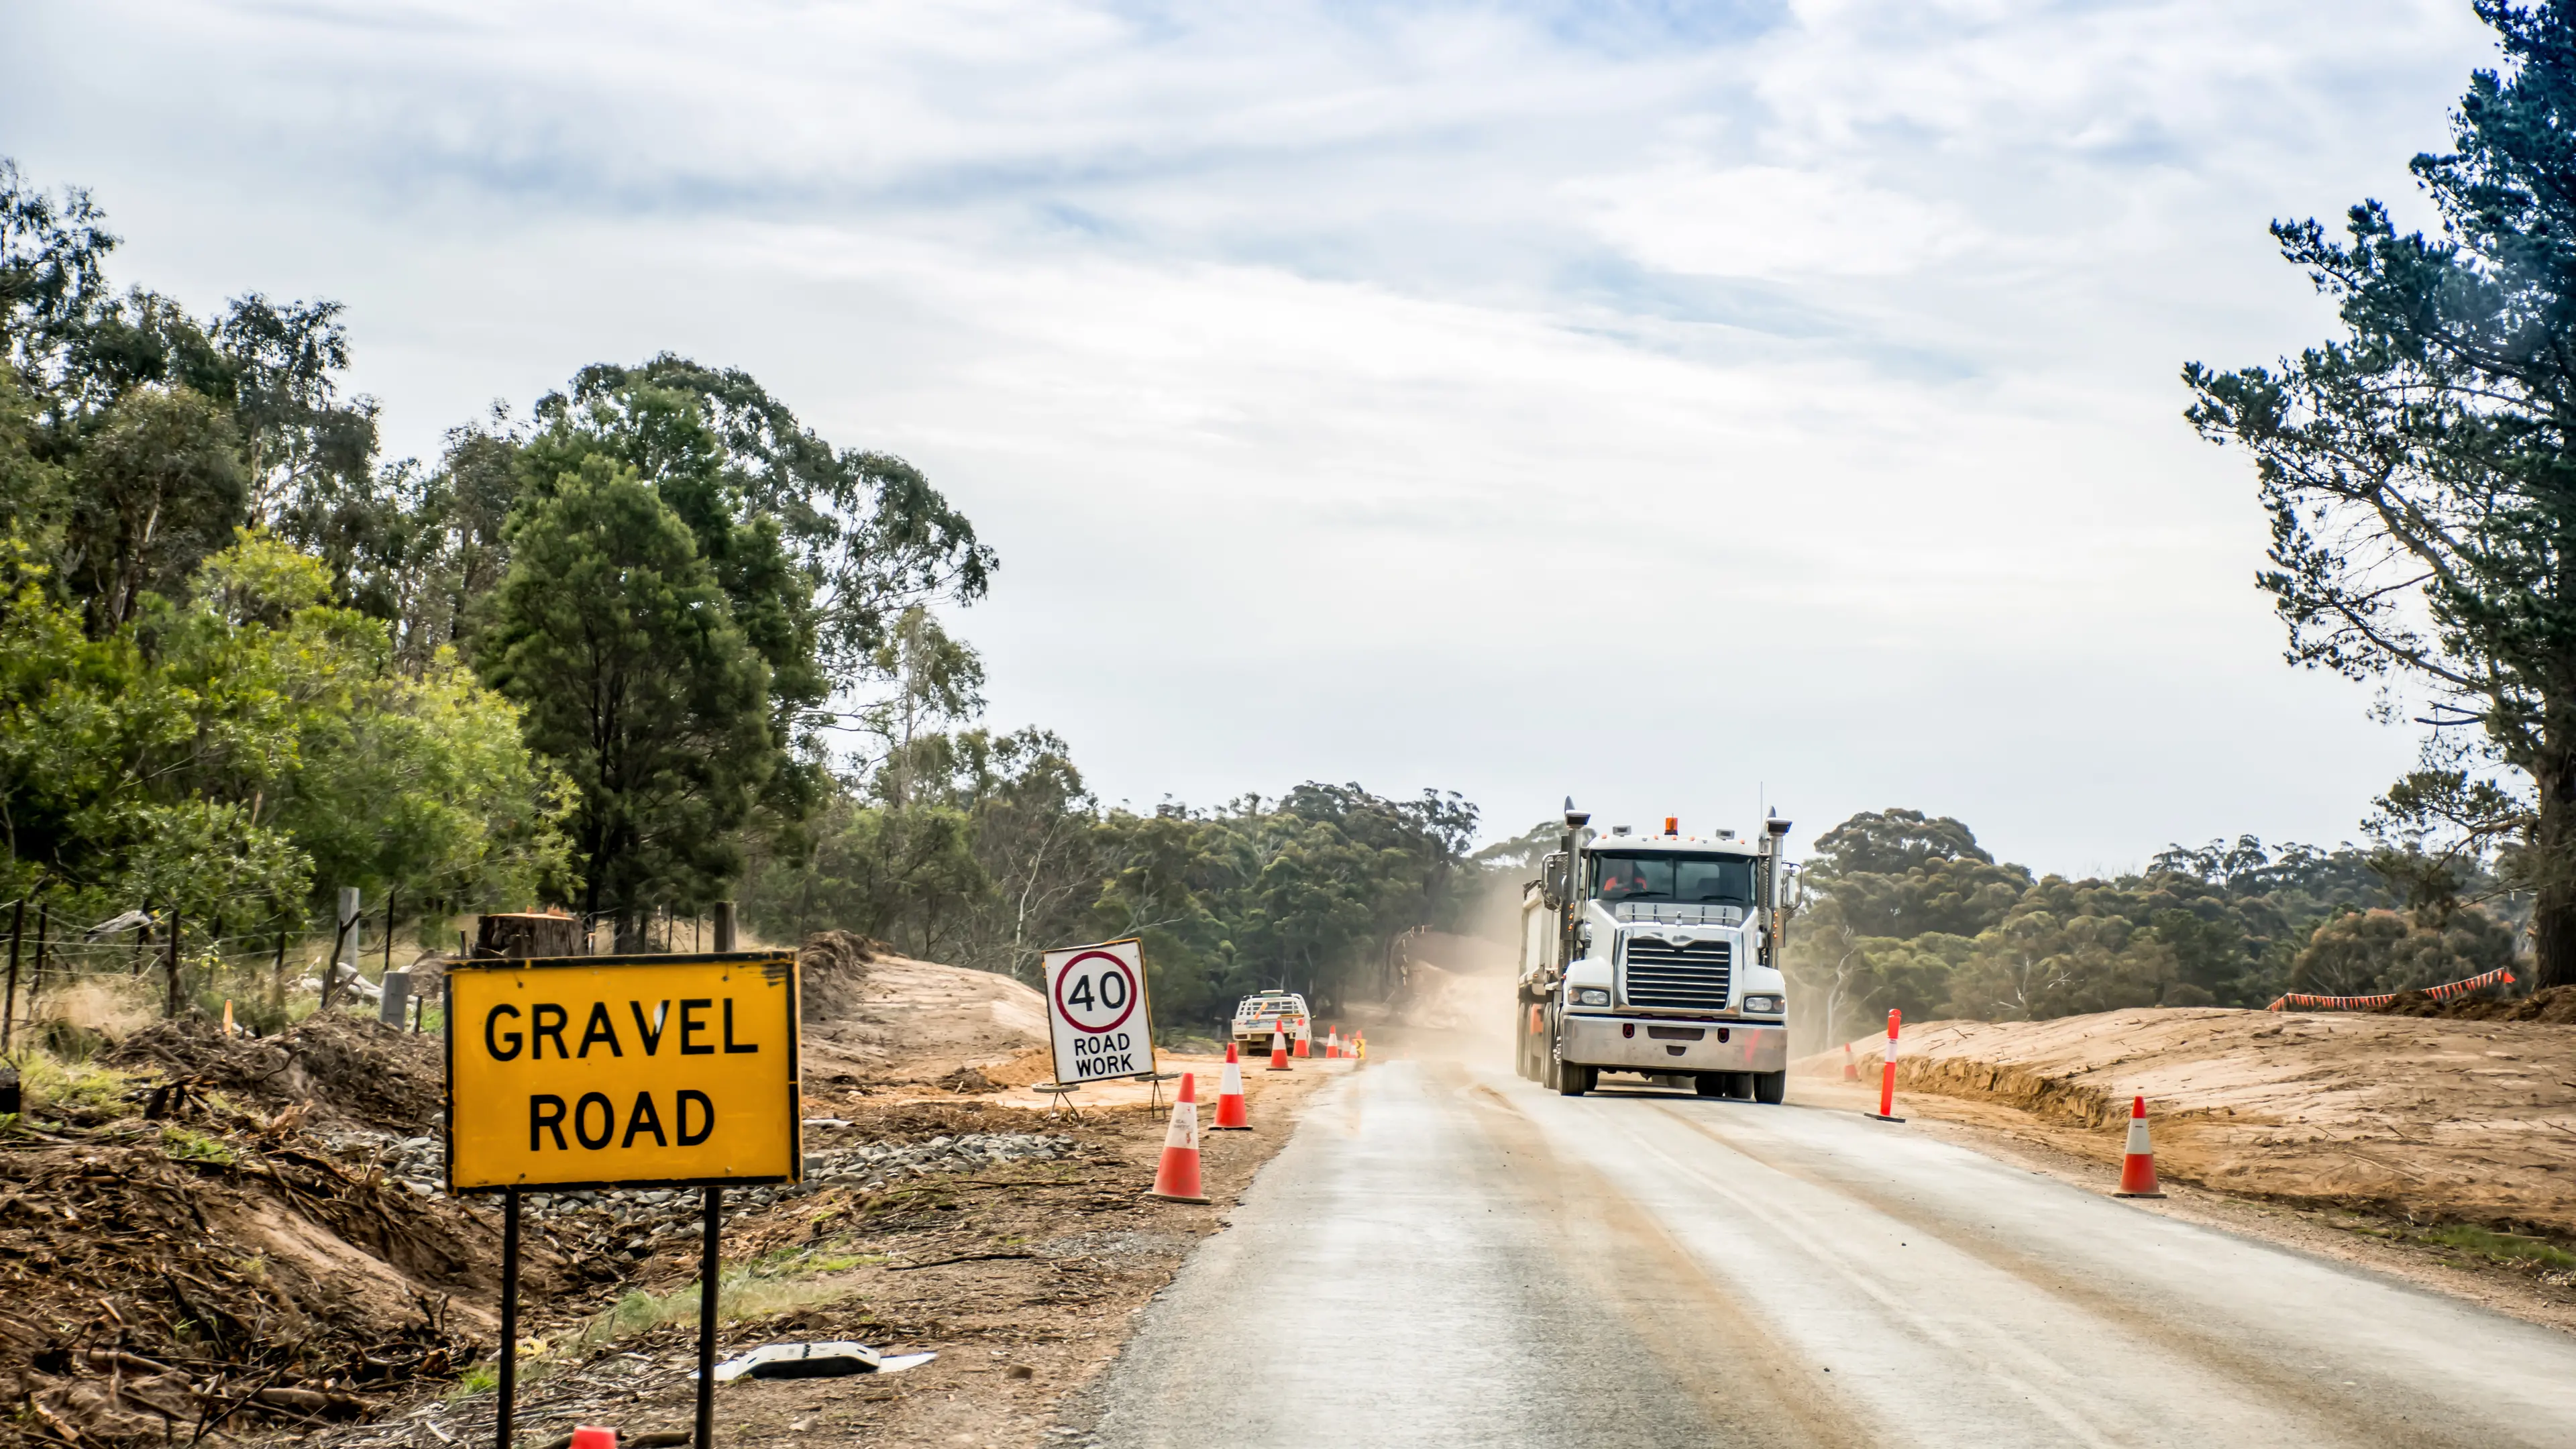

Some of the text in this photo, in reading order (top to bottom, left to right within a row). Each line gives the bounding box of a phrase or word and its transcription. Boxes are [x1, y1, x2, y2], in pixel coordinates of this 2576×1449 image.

[1068, 971, 1126, 1012] 40
[484, 998, 759, 1061] GRAVEL
[1074, 1033, 1130, 1056] ROAD
[1076, 1053, 1134, 1077] WORK
[530, 1089, 714, 1151] ROAD
